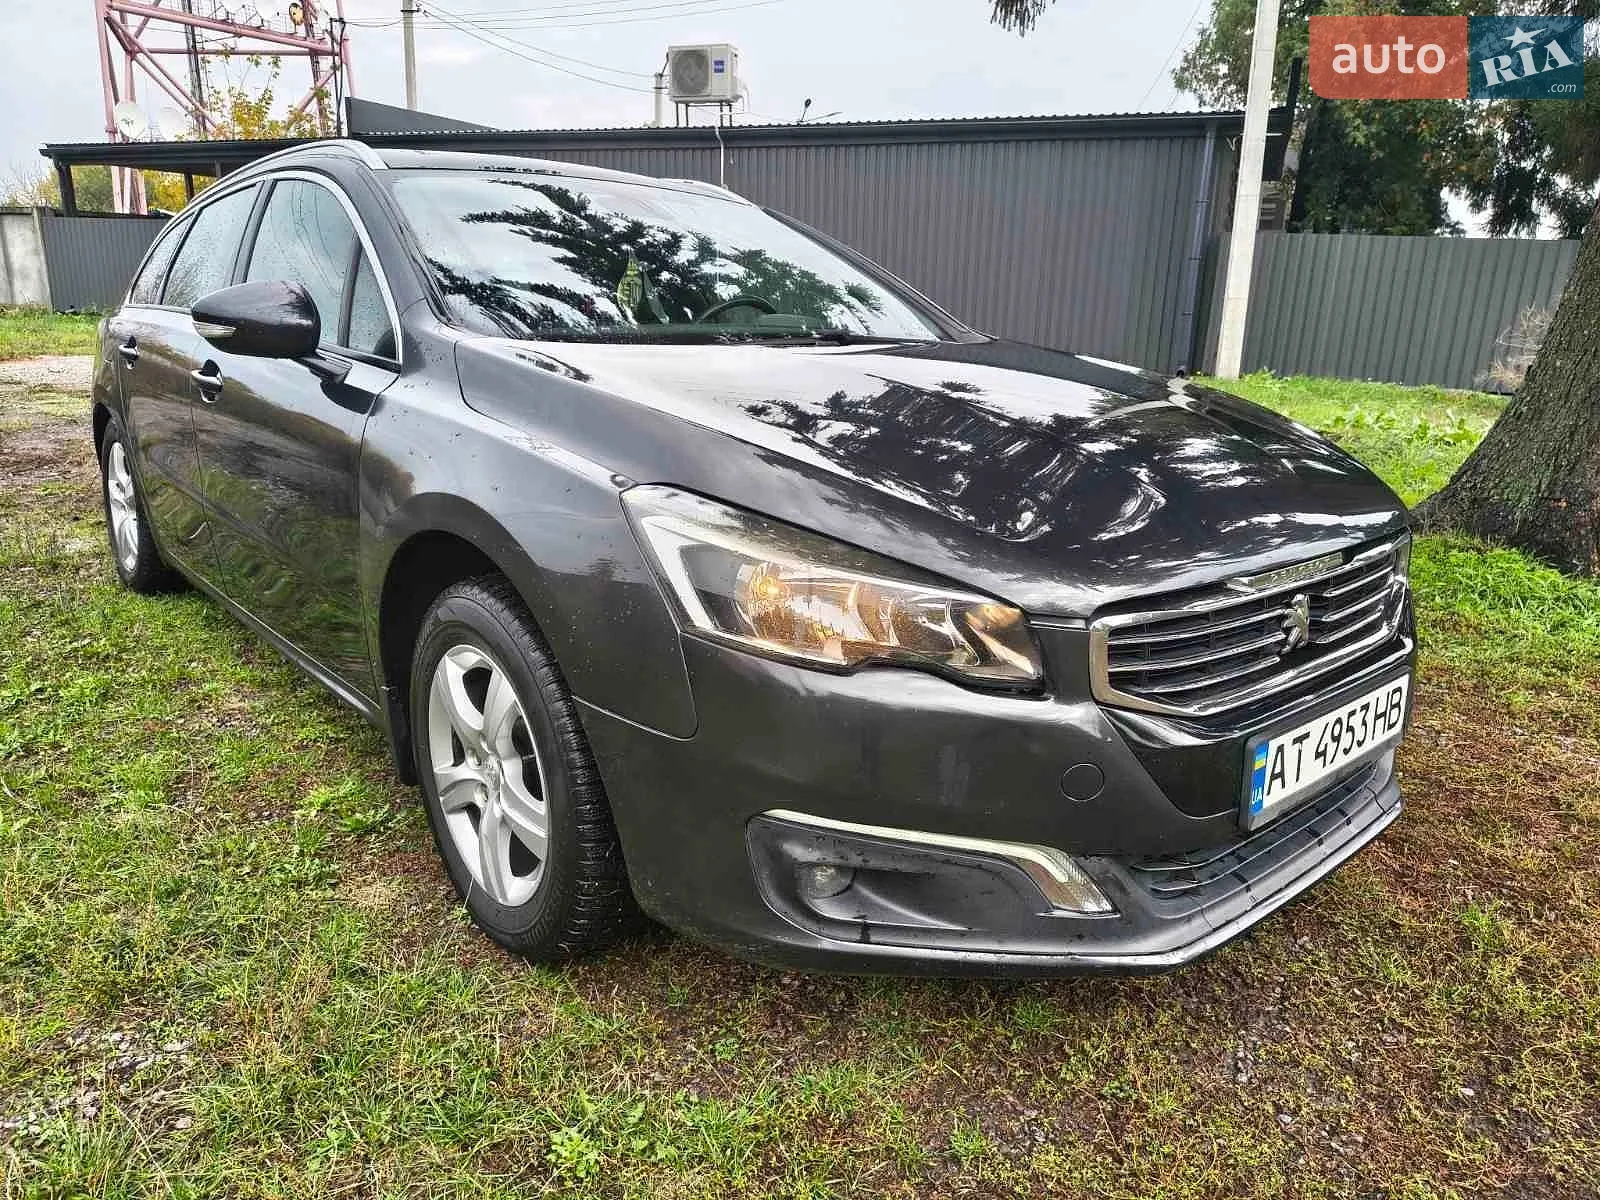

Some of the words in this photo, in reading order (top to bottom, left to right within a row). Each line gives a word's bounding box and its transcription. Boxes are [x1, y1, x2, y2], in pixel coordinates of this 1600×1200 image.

[1266, 731, 1310, 796] AT
[1314, 702, 1371, 768] 4953
[1371, 686, 1403, 741] HB
[1251, 787, 1263, 804] UA
